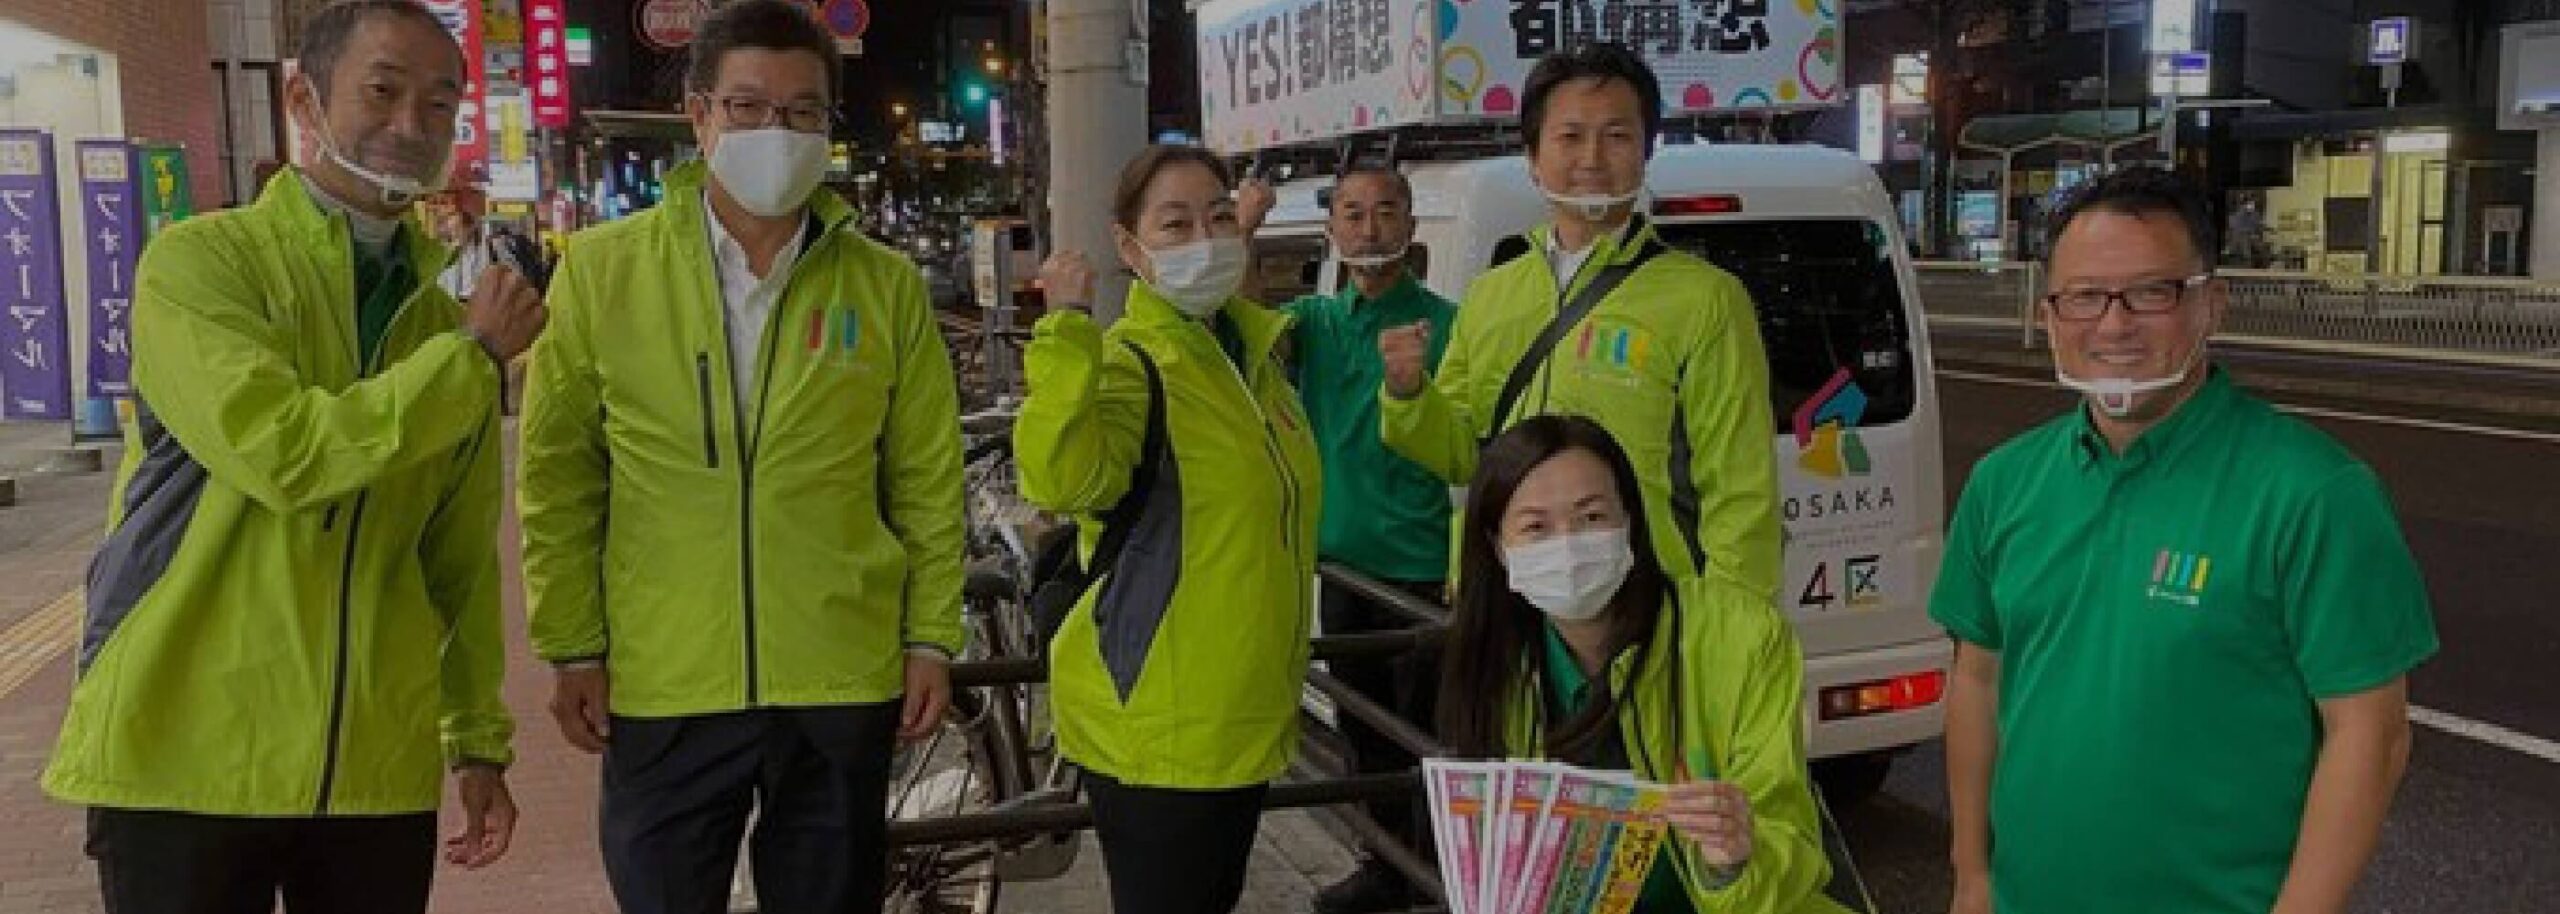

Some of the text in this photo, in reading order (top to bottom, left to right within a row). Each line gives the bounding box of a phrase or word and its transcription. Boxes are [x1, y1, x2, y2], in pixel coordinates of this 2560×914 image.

[2, 189, 49, 371] フォーマル
[1784, 486, 1895, 521] OSAKA
